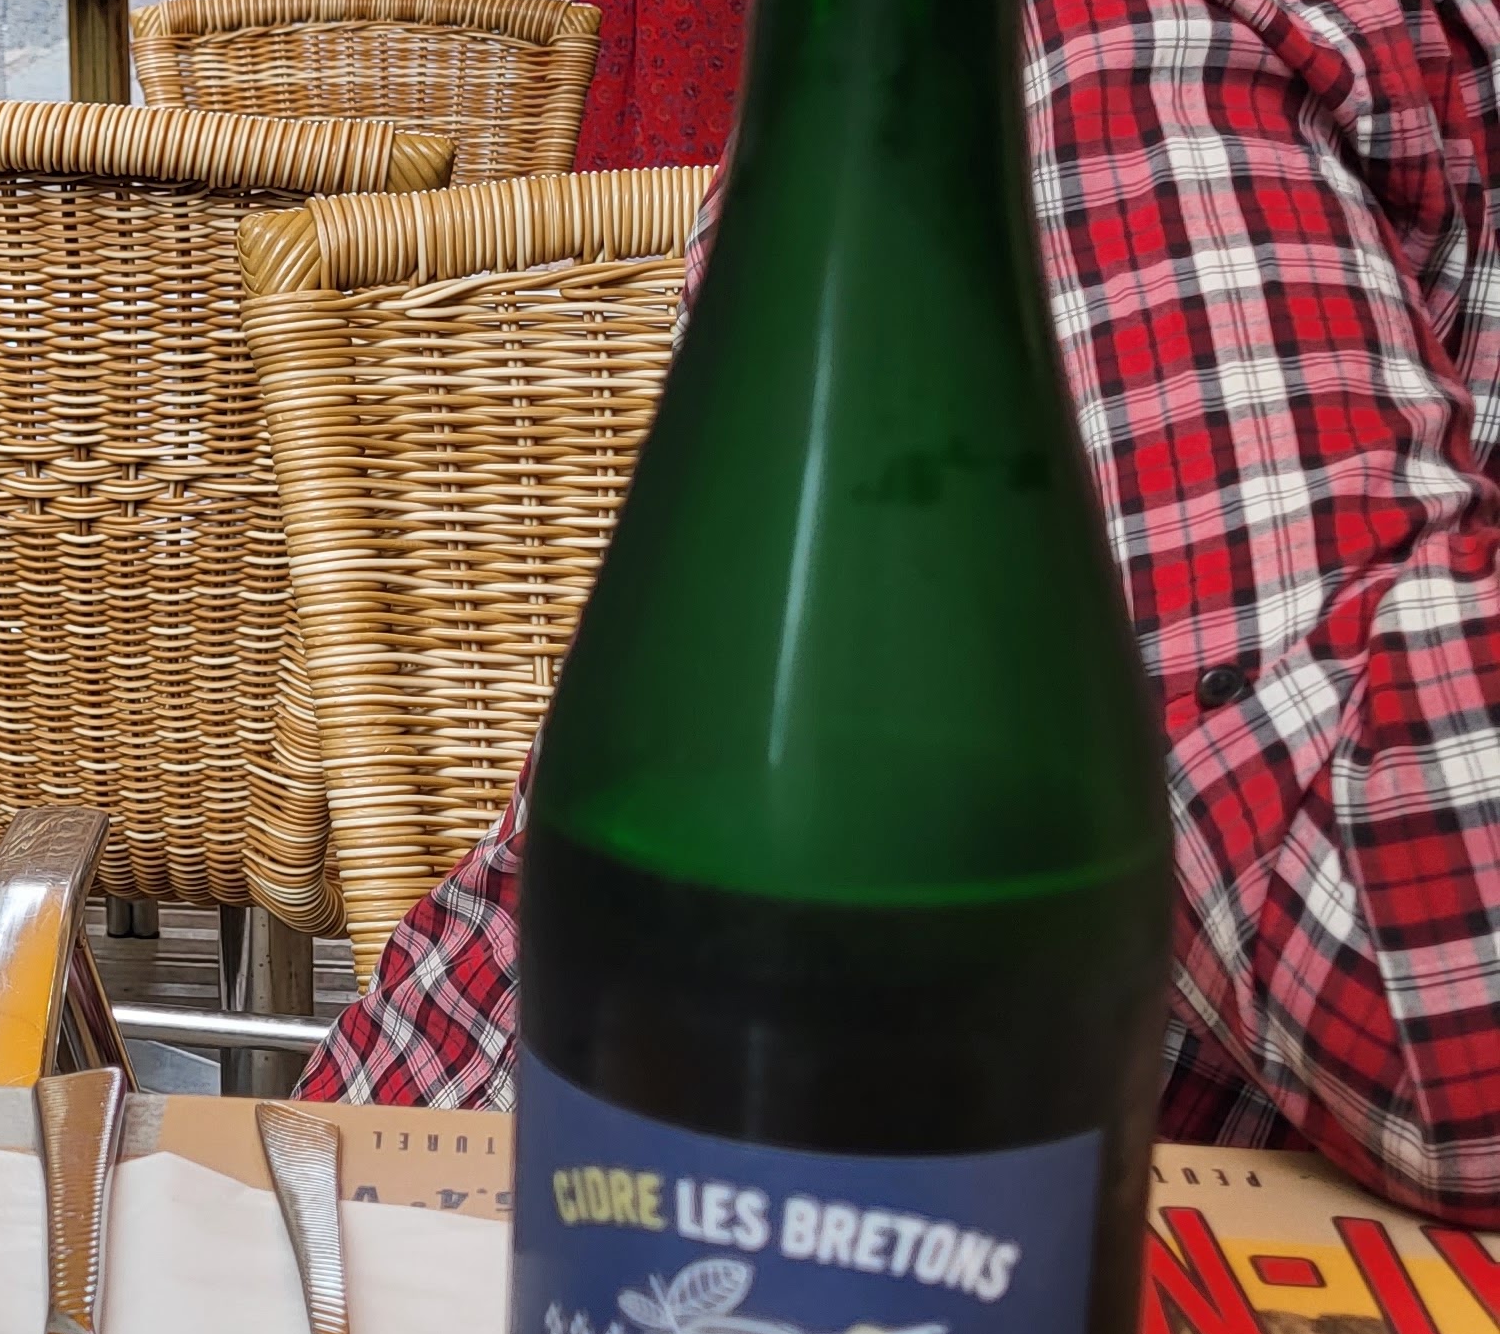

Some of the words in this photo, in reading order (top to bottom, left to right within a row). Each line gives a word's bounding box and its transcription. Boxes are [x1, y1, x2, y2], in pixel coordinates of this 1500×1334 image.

[554, 1167, 665, 1230] CIDRE
[676, 1178, 769, 1251] LES
[781, 1194, 1021, 1302] BRETONS
